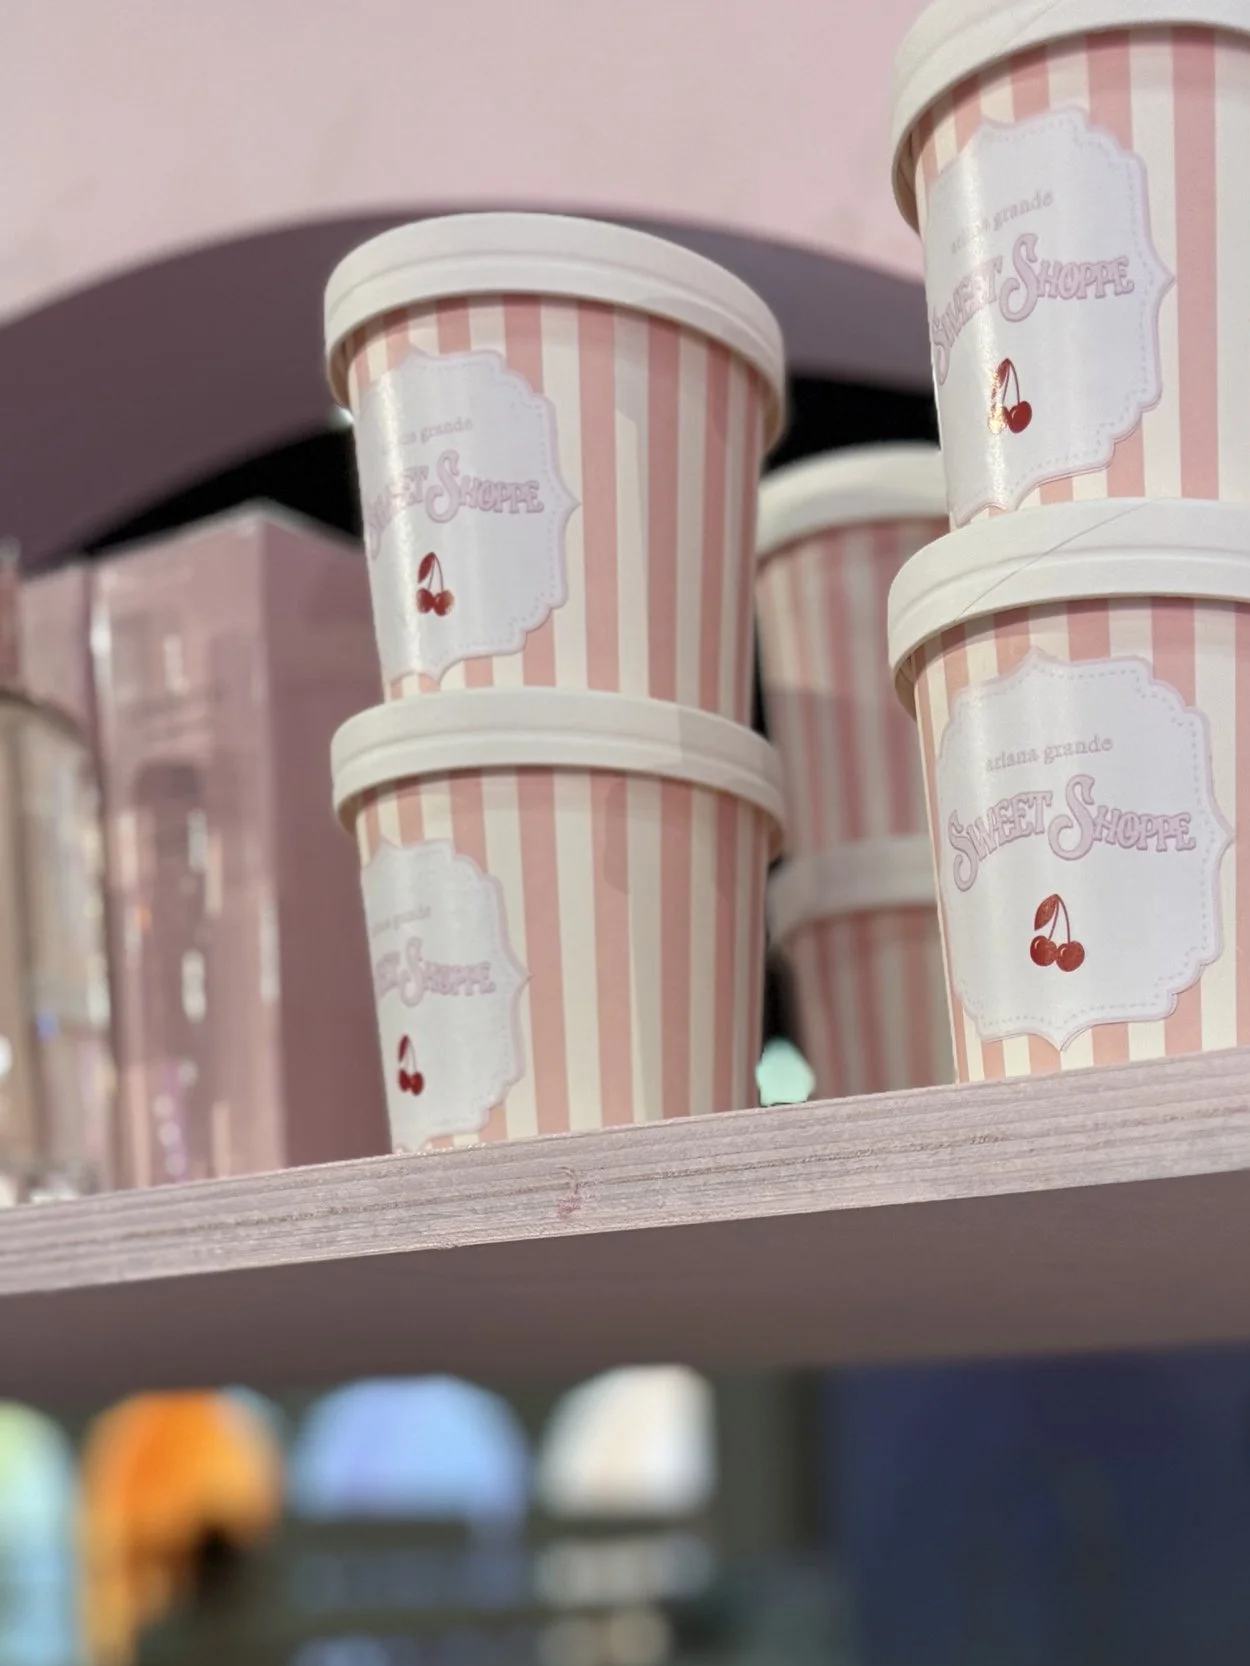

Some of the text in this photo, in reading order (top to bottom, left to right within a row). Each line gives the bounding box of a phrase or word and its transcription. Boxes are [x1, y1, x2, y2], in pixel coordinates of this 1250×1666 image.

[1000, 232, 1135, 323] SHOPPE
[425, 448, 545, 524] SHOPPE
[1043, 734, 1114, 765] grande
[948, 773, 1197, 892] SWEET SHOPPE
